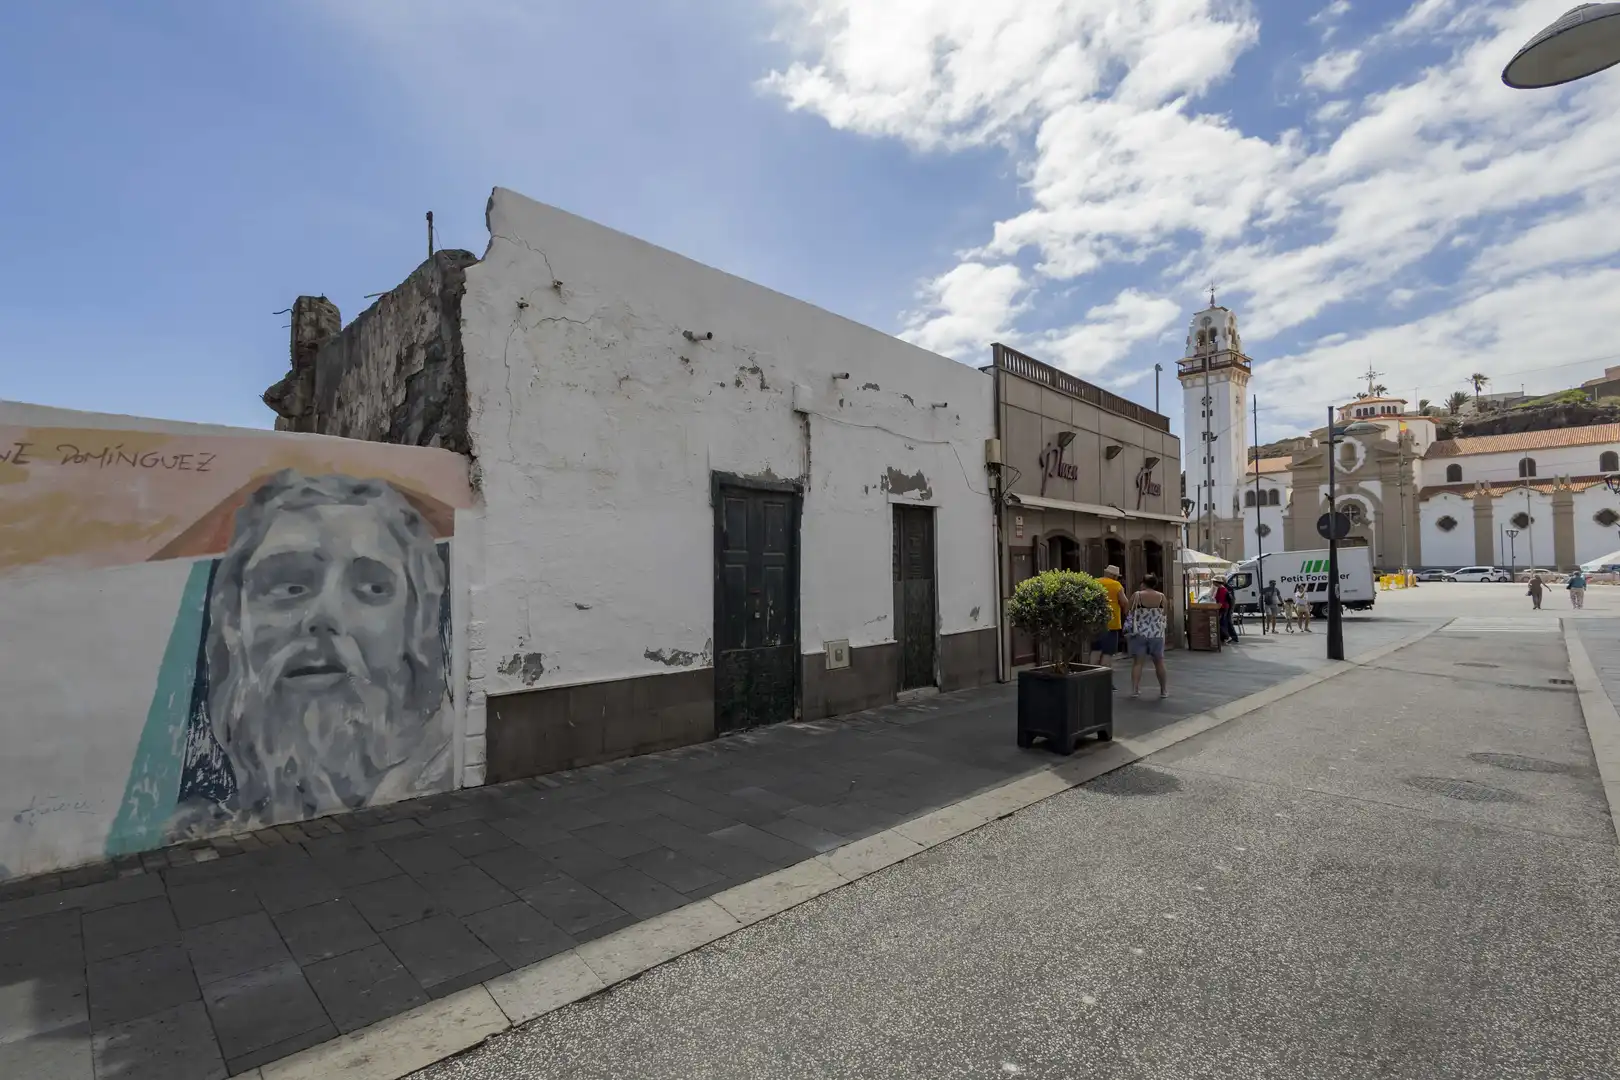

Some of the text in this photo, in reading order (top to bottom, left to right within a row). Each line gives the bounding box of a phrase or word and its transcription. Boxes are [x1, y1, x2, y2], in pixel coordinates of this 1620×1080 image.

[56, 443, 216, 472] DOMÍNGUEZ
[1280, 573, 1350, 583] Petit Foreer
